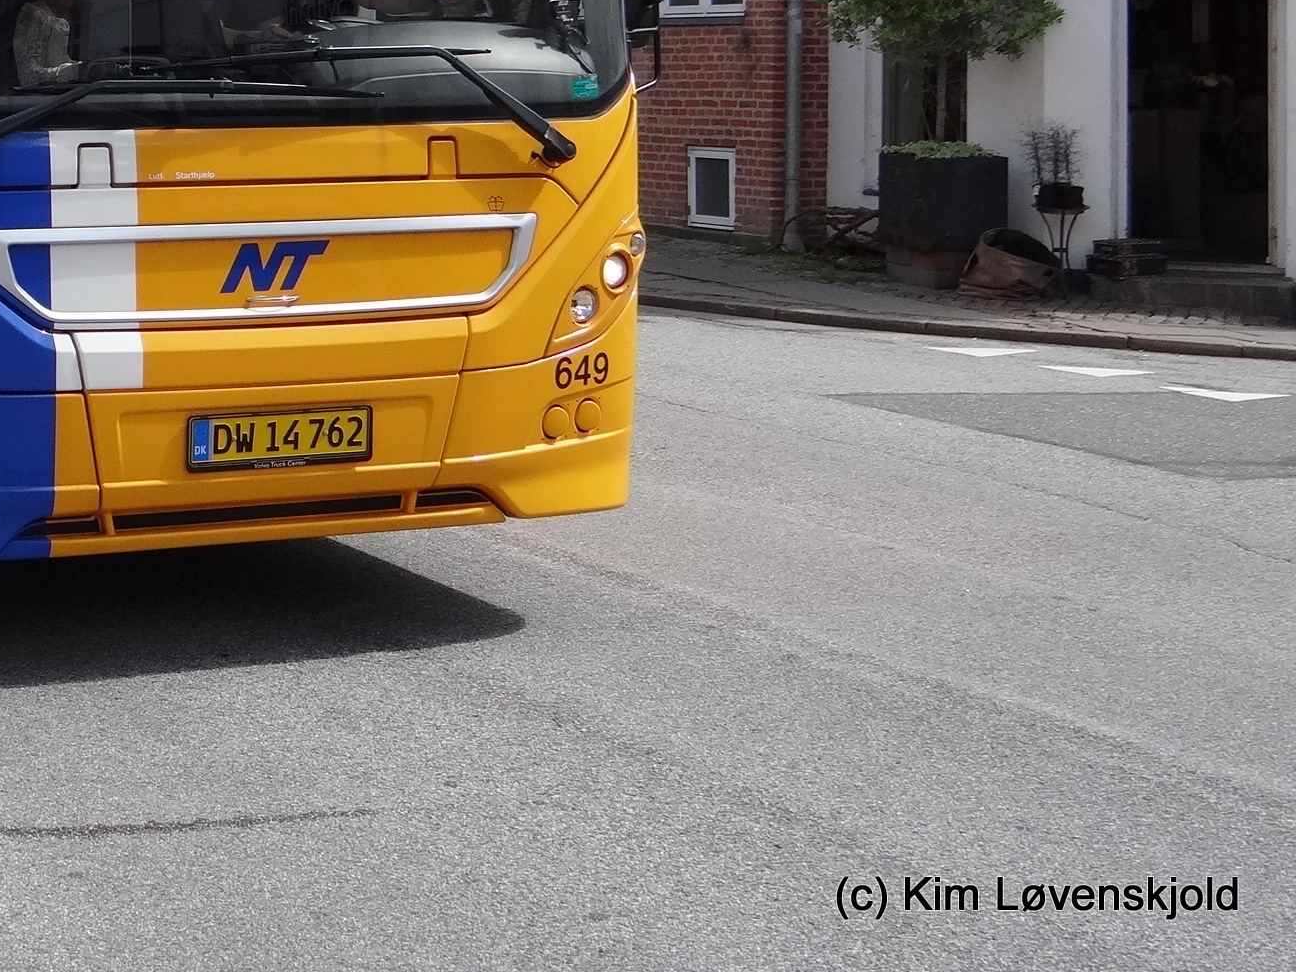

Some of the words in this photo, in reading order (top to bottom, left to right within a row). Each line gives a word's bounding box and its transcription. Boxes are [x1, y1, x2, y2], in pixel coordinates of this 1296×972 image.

[175, 171, 215, 180] Starthjælp
[219, 239, 331, 294] NT
[555, 352, 609, 389] 649
[194, 445, 207, 456] DK
[212, 422, 256, 455] DW
